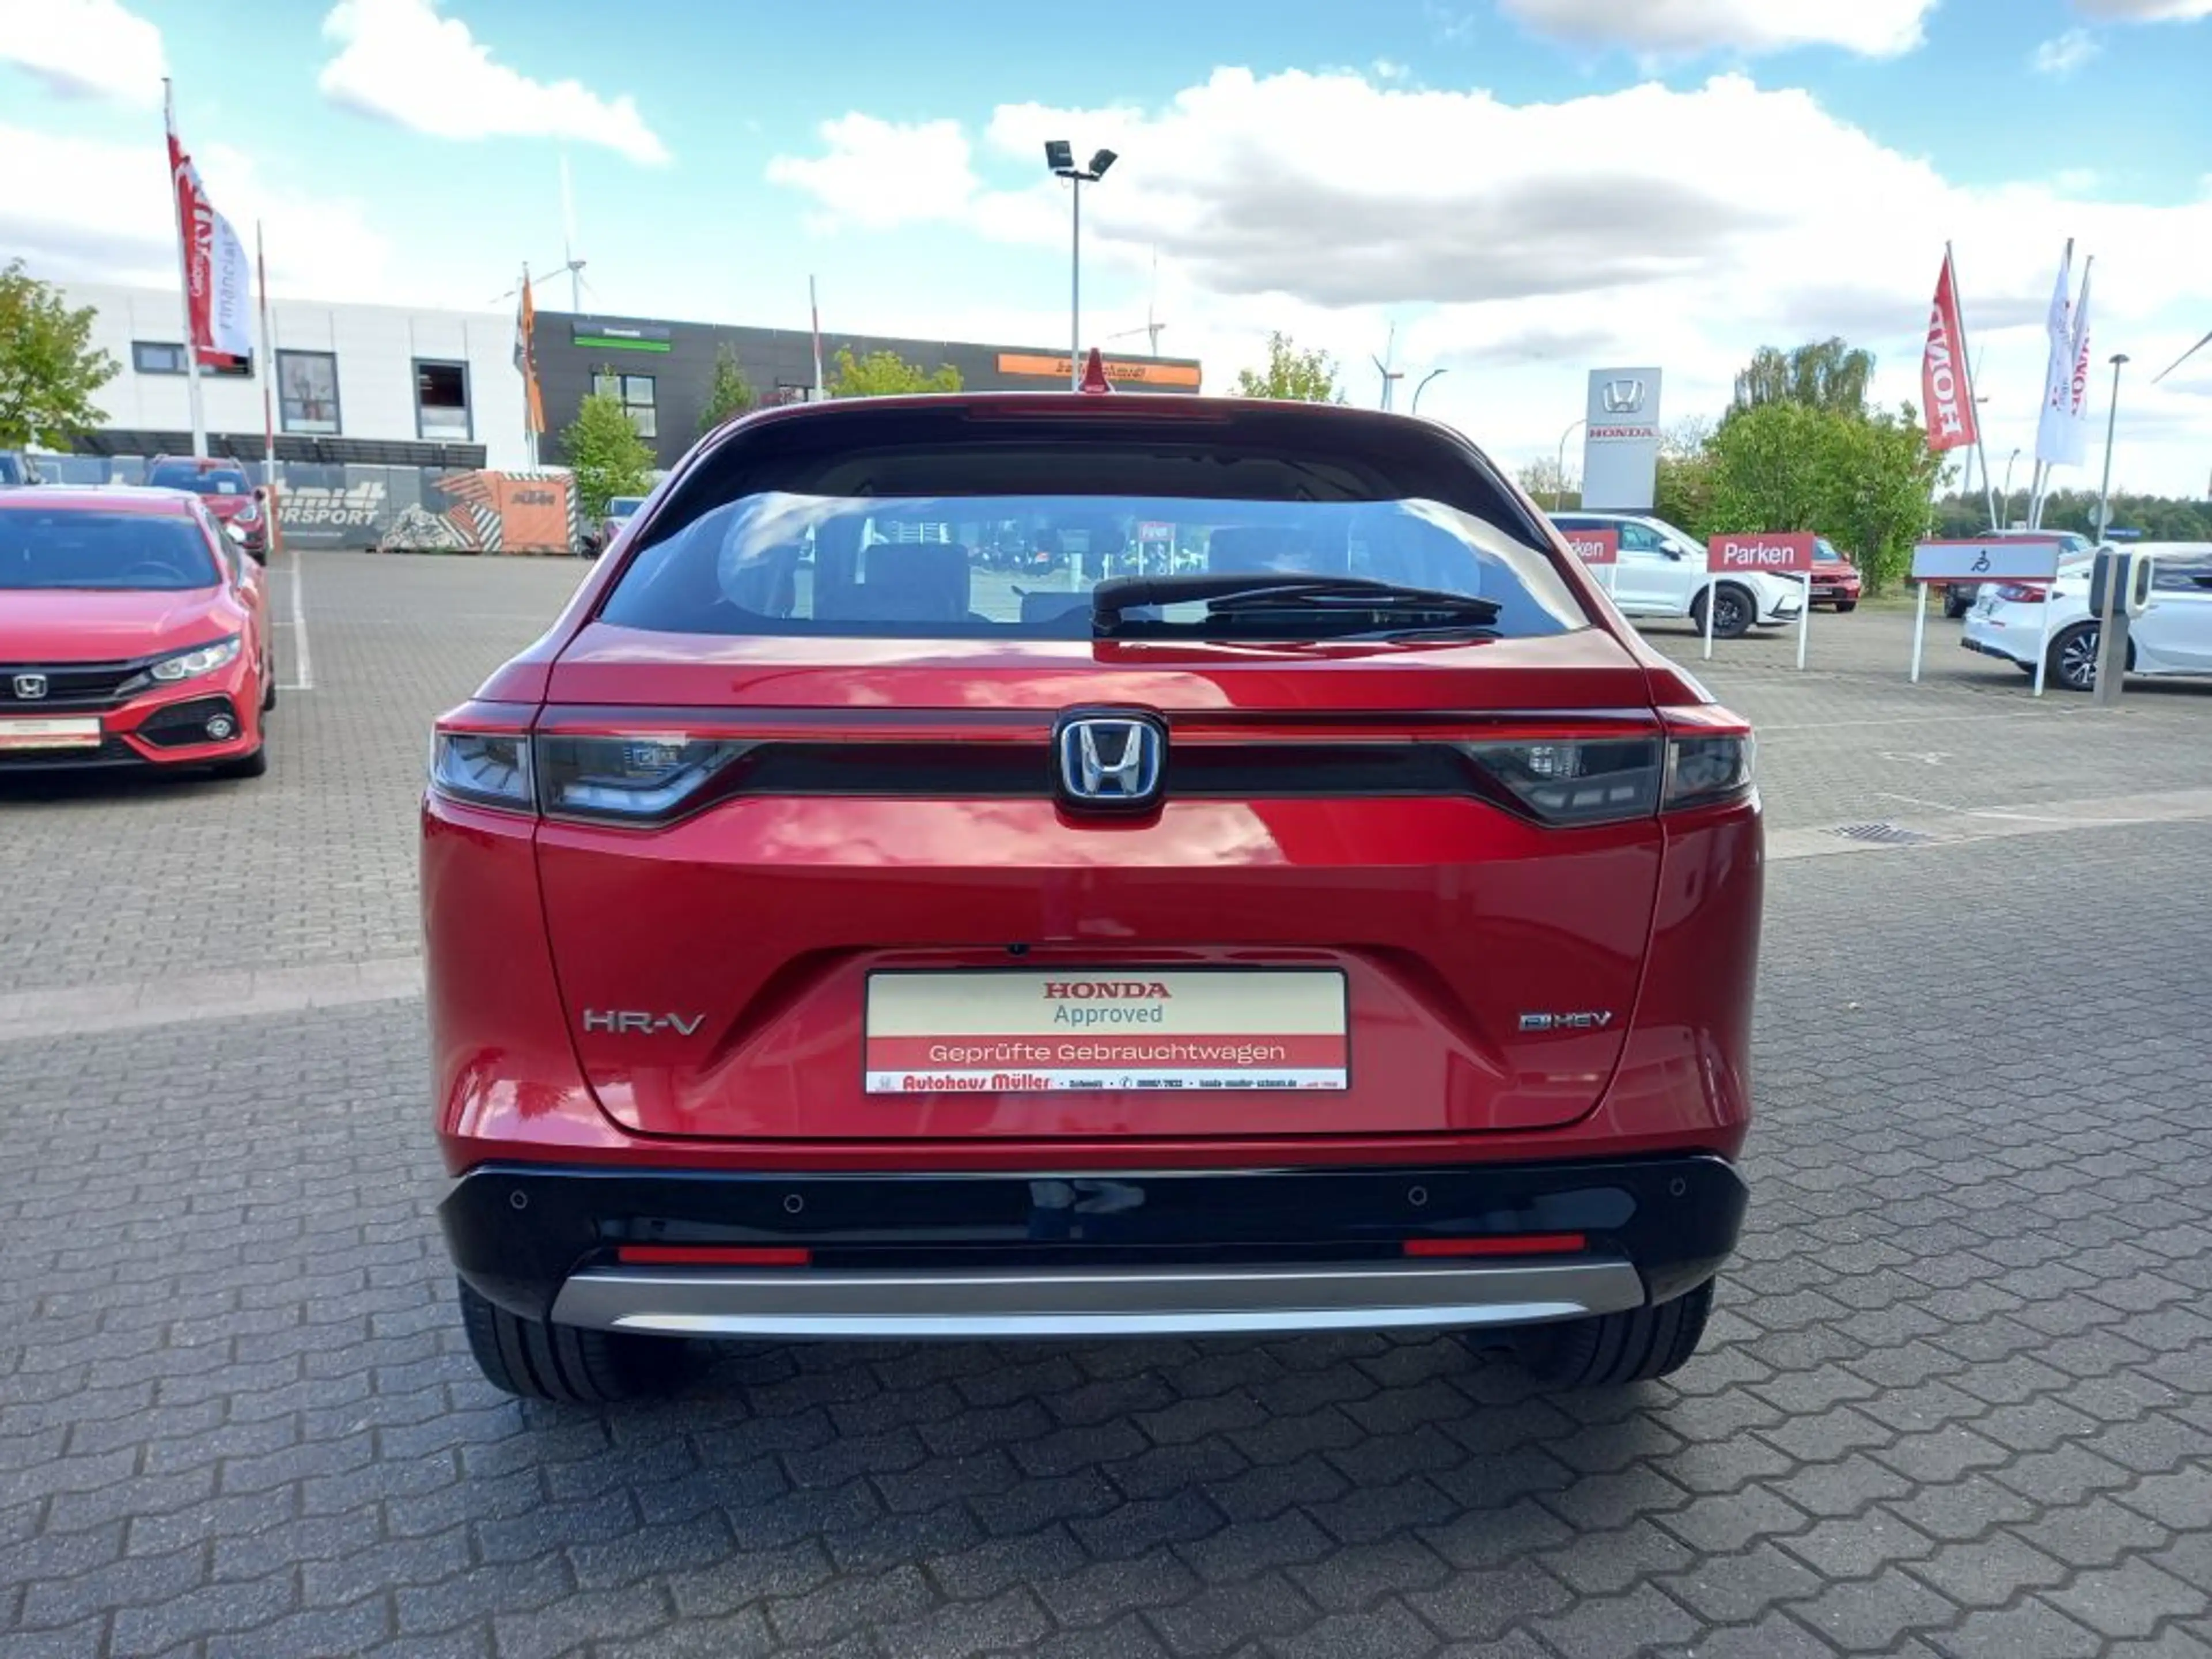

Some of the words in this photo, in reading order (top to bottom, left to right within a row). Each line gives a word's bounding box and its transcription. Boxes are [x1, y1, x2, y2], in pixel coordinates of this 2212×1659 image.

[1590, 428, 1655, 438] HONDA
[1724, 542, 1794, 565] Parken
[1043, 982, 1172, 999] HONDA
[583, 1009, 706, 1036] HR-V
[1054, 1004, 1163, 1027] Approved
[929, 1043, 1051, 1063] Geprüfte
[1057, 1042, 1286, 1064] Gebrauchtwagen
[903, 1074, 986, 1090] Autohaus
[991, 1073, 1051, 1090] Müller
